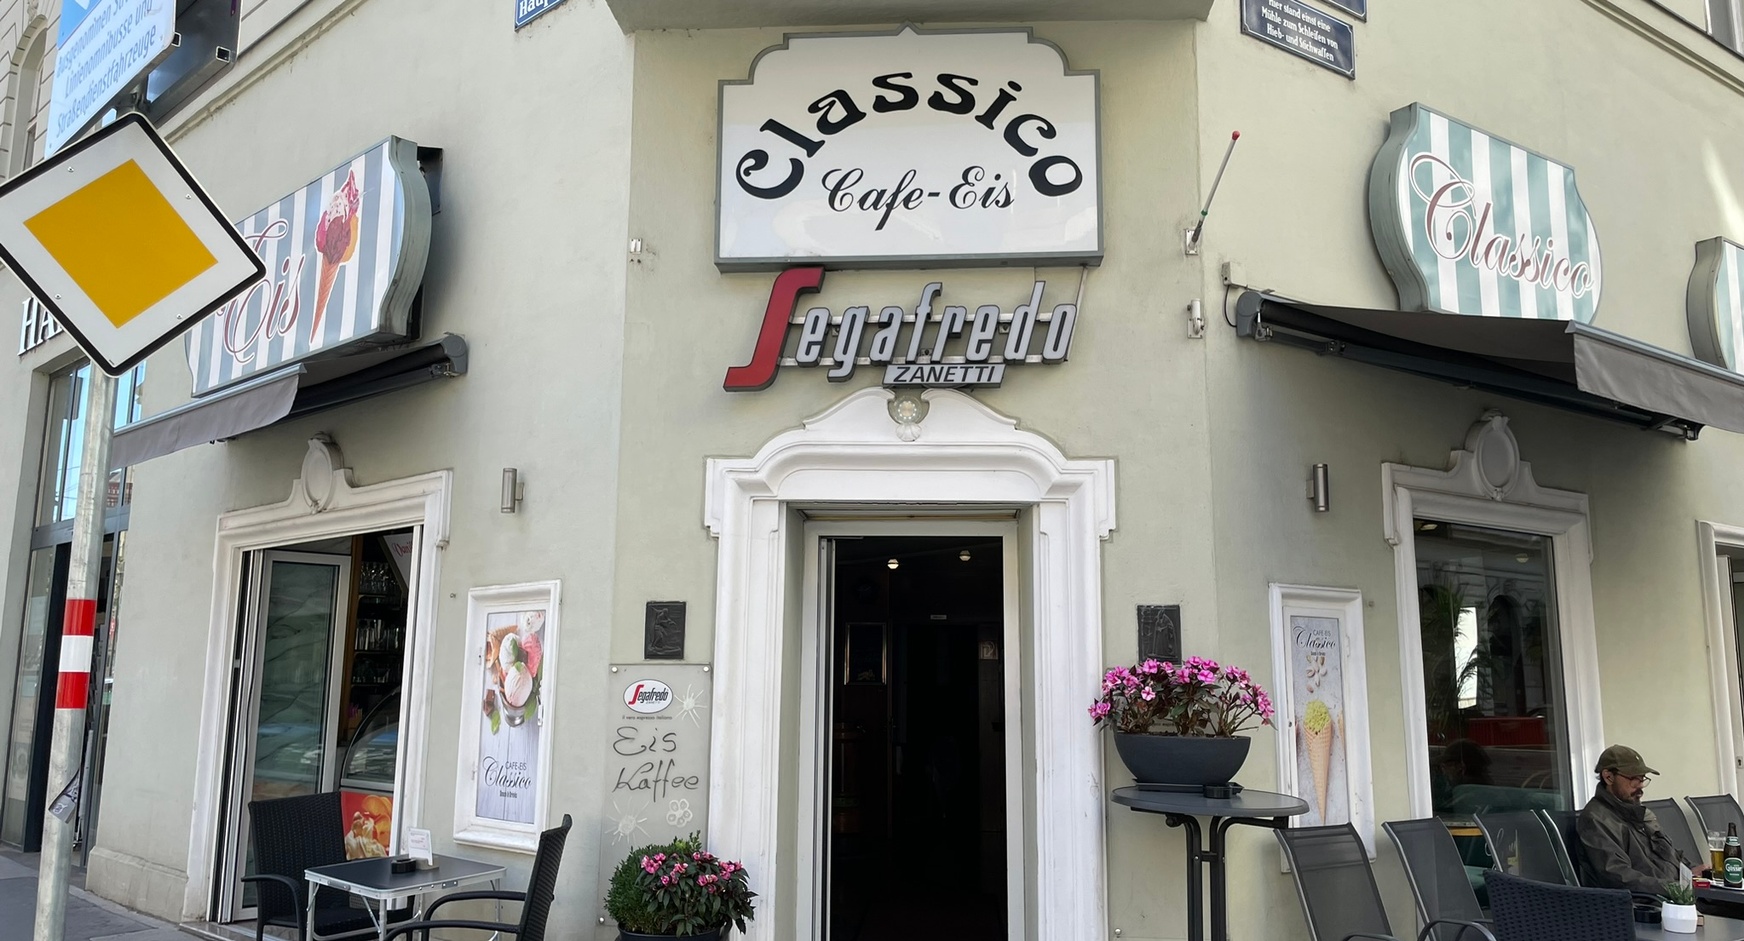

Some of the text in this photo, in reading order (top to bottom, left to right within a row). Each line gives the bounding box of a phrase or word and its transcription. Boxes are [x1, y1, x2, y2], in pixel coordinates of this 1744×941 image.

[1261, 6, 1339, 50] Mühle zum Schleifen von
[1285, 34, 1299, 47] und
[1298, 36, 1335, 62] Stichwaffen
[1317, 19, 1331, 33] eine
[56, 24, 156, 138] Straßendienstfahrzeuge
[735, 71, 1083, 200] Classico
[821, 165, 1015, 231] Cafe-Eis
[1409, 152, 1595, 298] Classico
[17, 296, 63, 356] HA
[723, 266, 1078, 392] Segafredo
[892, 365, 996, 383] ZANETTI
[1292, 625, 1336, 649] Classico
[627, 683, 669, 705] Segafredo
[613, 726, 677, 756] Eis
[482, 755, 532, 790] Classico
[611, 758, 700, 803] Kaffee
